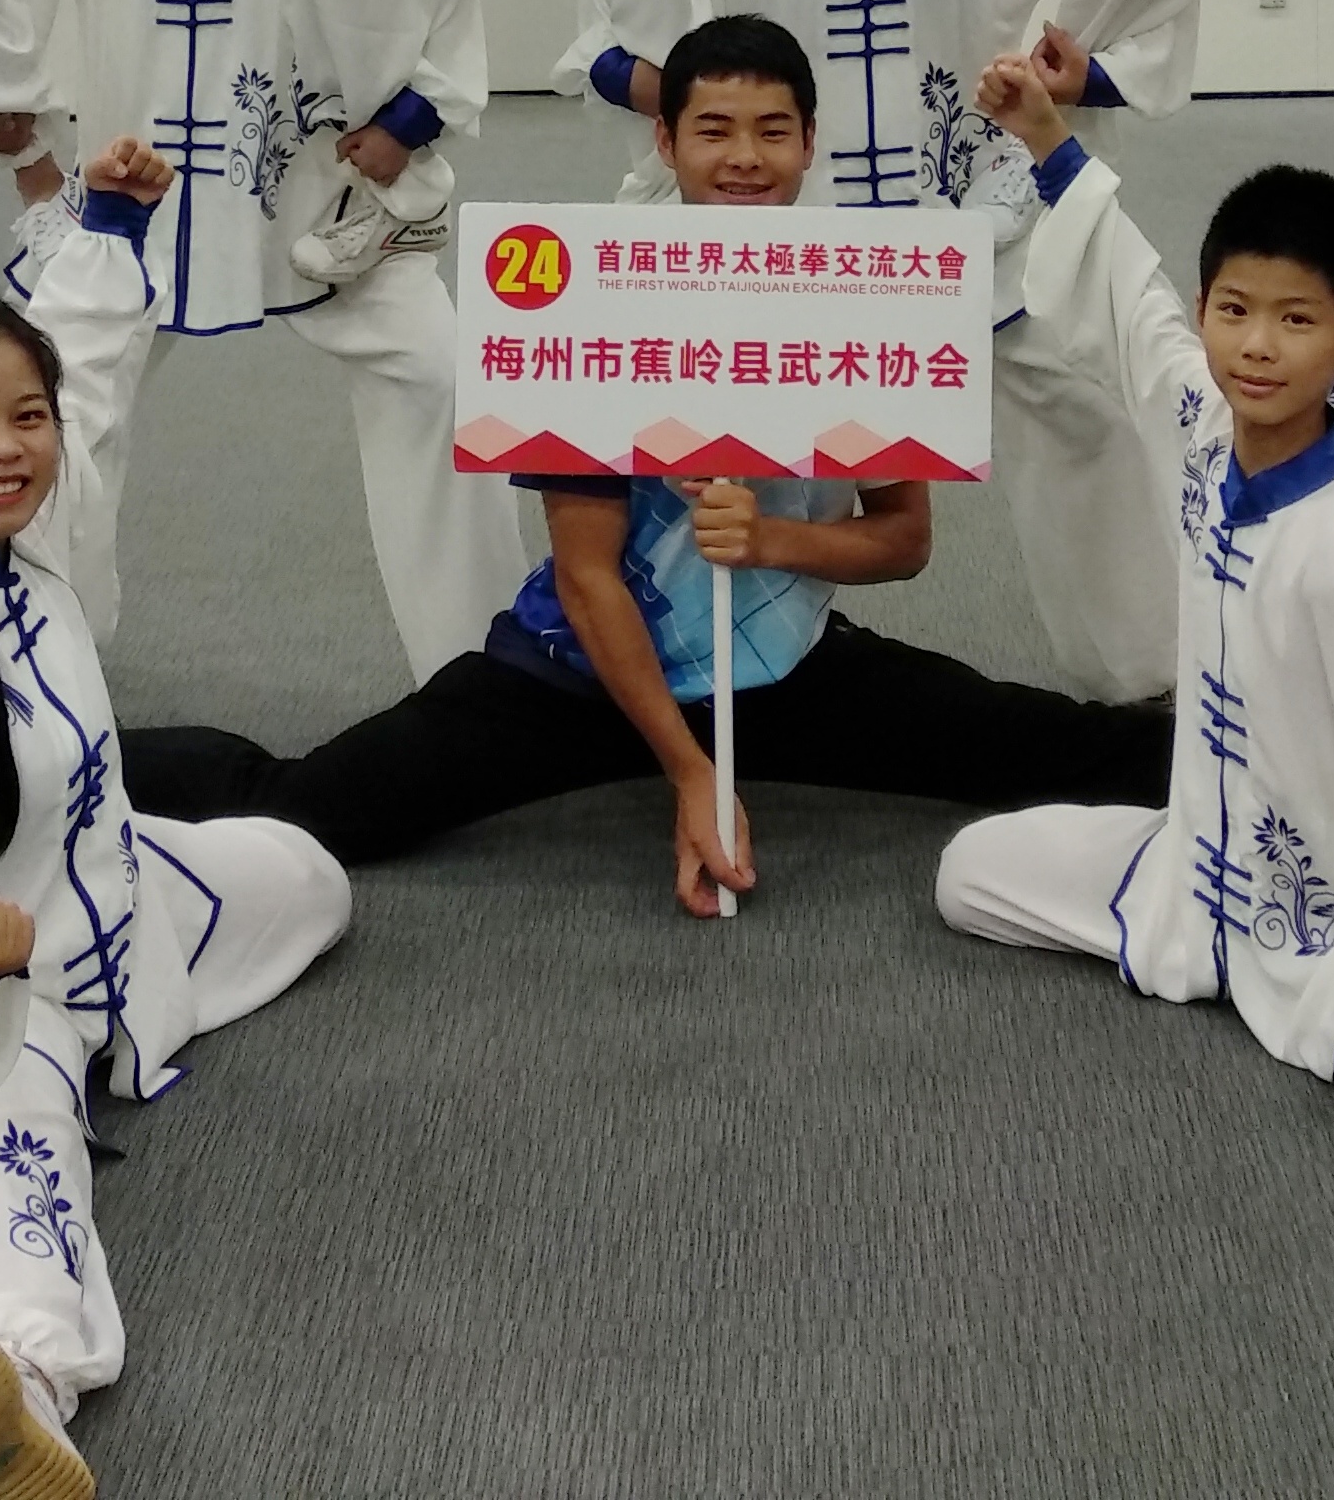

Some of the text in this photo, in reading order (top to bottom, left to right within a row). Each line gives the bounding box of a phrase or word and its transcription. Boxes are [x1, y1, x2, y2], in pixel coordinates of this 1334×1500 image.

[495, 238, 563, 293] 24
[594, 240, 967, 280] 首届世界太極拳交流大會
[597, 279, 962, 297] THE FIRST WORLD TAIJIQUAN EXCHANGE CONFERENCE
[482, 335, 969, 389] 梅州市蕉岭县武术协会
